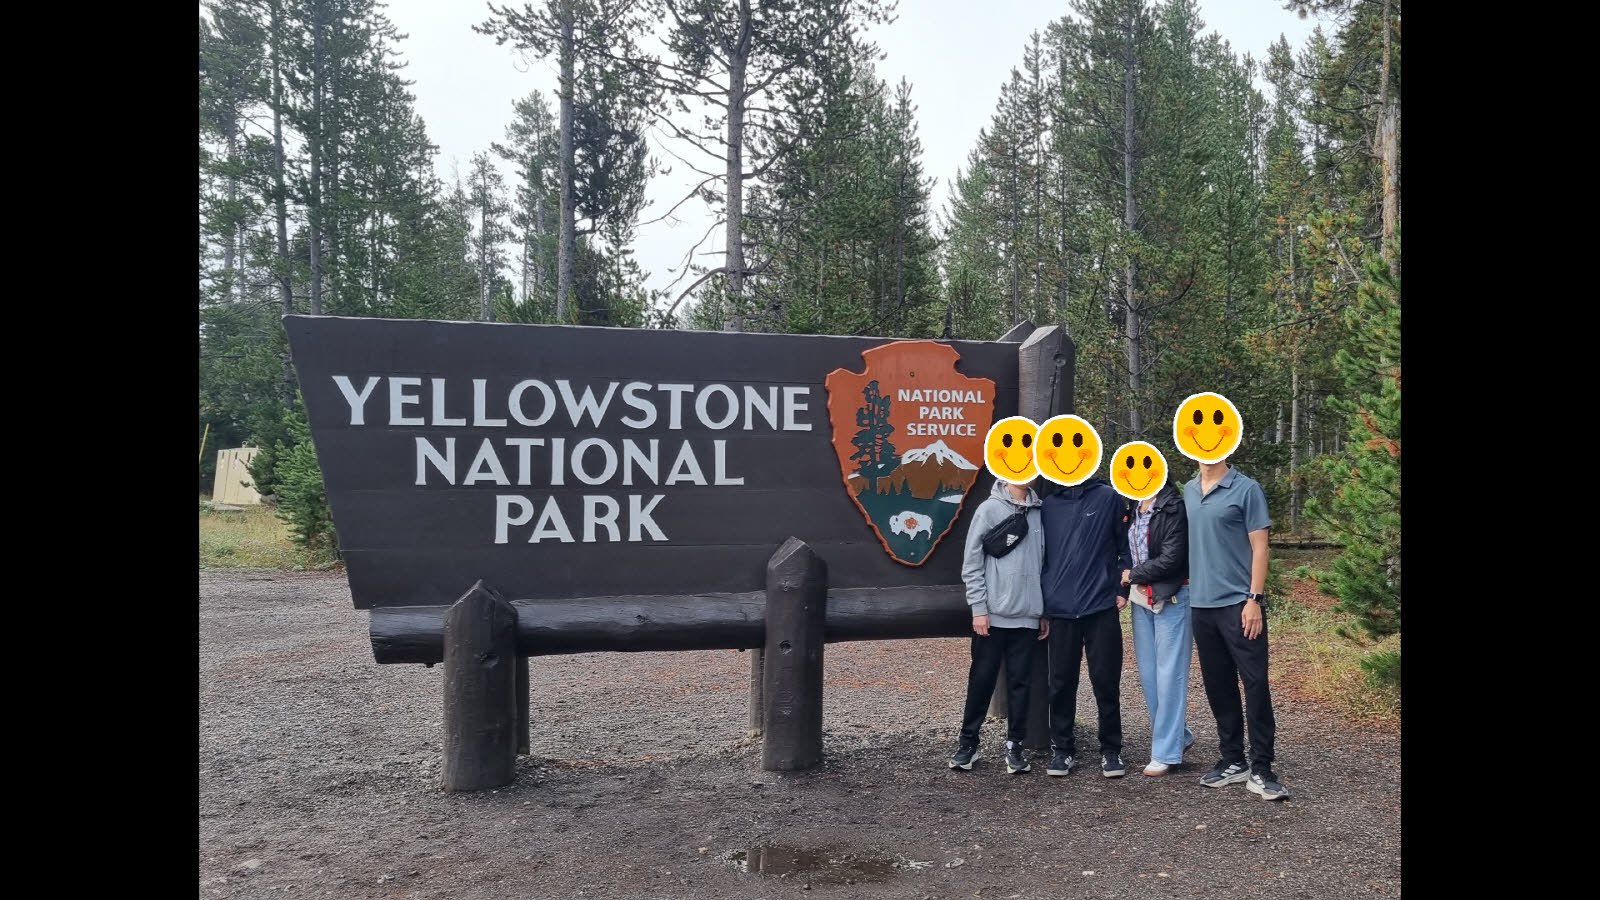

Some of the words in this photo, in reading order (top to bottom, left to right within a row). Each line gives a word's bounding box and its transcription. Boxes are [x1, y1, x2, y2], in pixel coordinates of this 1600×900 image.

[332, 376, 812, 431] YELLOWSTONE
[897, 389, 985, 404] NATIONAL
[919, 406, 964, 420] PARK
[906, 423, 976, 437] SERVICE
[415, 437, 744, 486] NATIONAL
[494, 494, 669, 544] PARK
